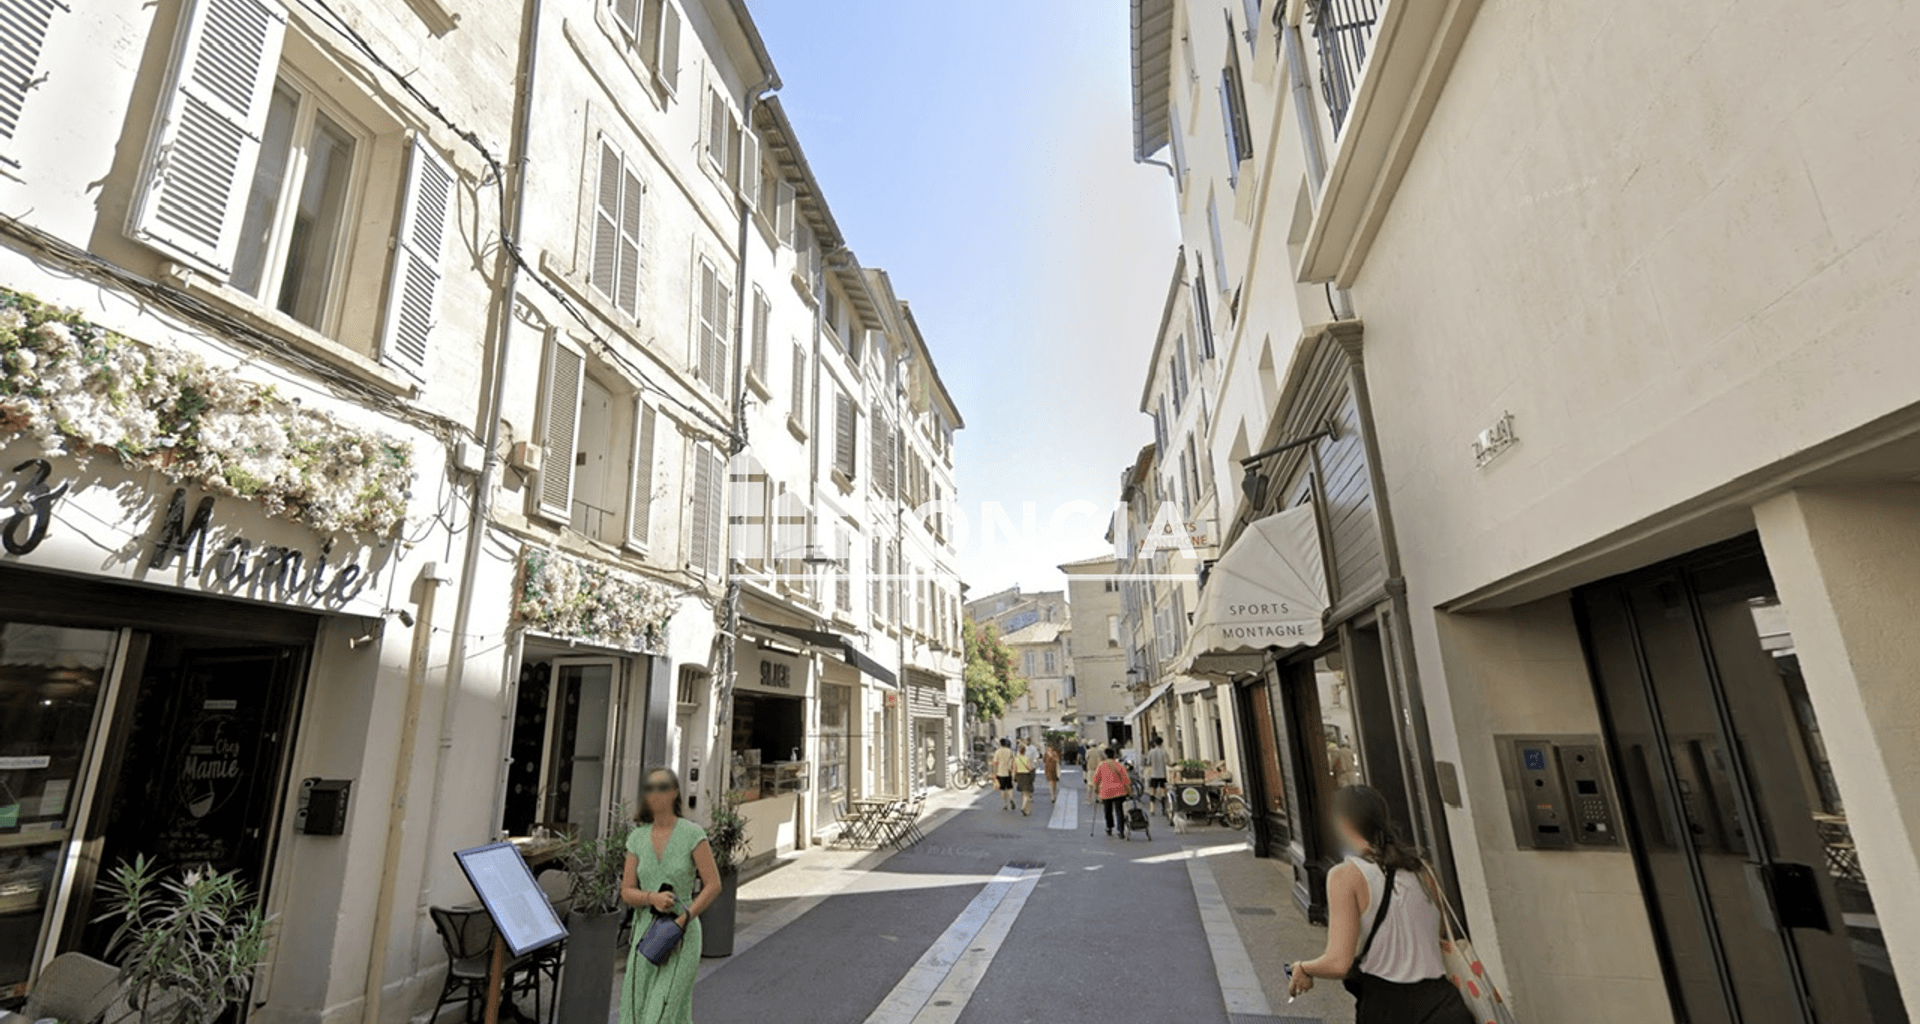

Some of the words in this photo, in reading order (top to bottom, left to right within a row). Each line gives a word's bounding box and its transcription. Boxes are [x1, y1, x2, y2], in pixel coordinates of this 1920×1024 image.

[149, 487, 361, 604] Mamie
[1229, 602, 1289, 616] SPORTS
[1222, 624, 1305, 639] MONTAGNE
[182, 753, 240, 780] Mamie
